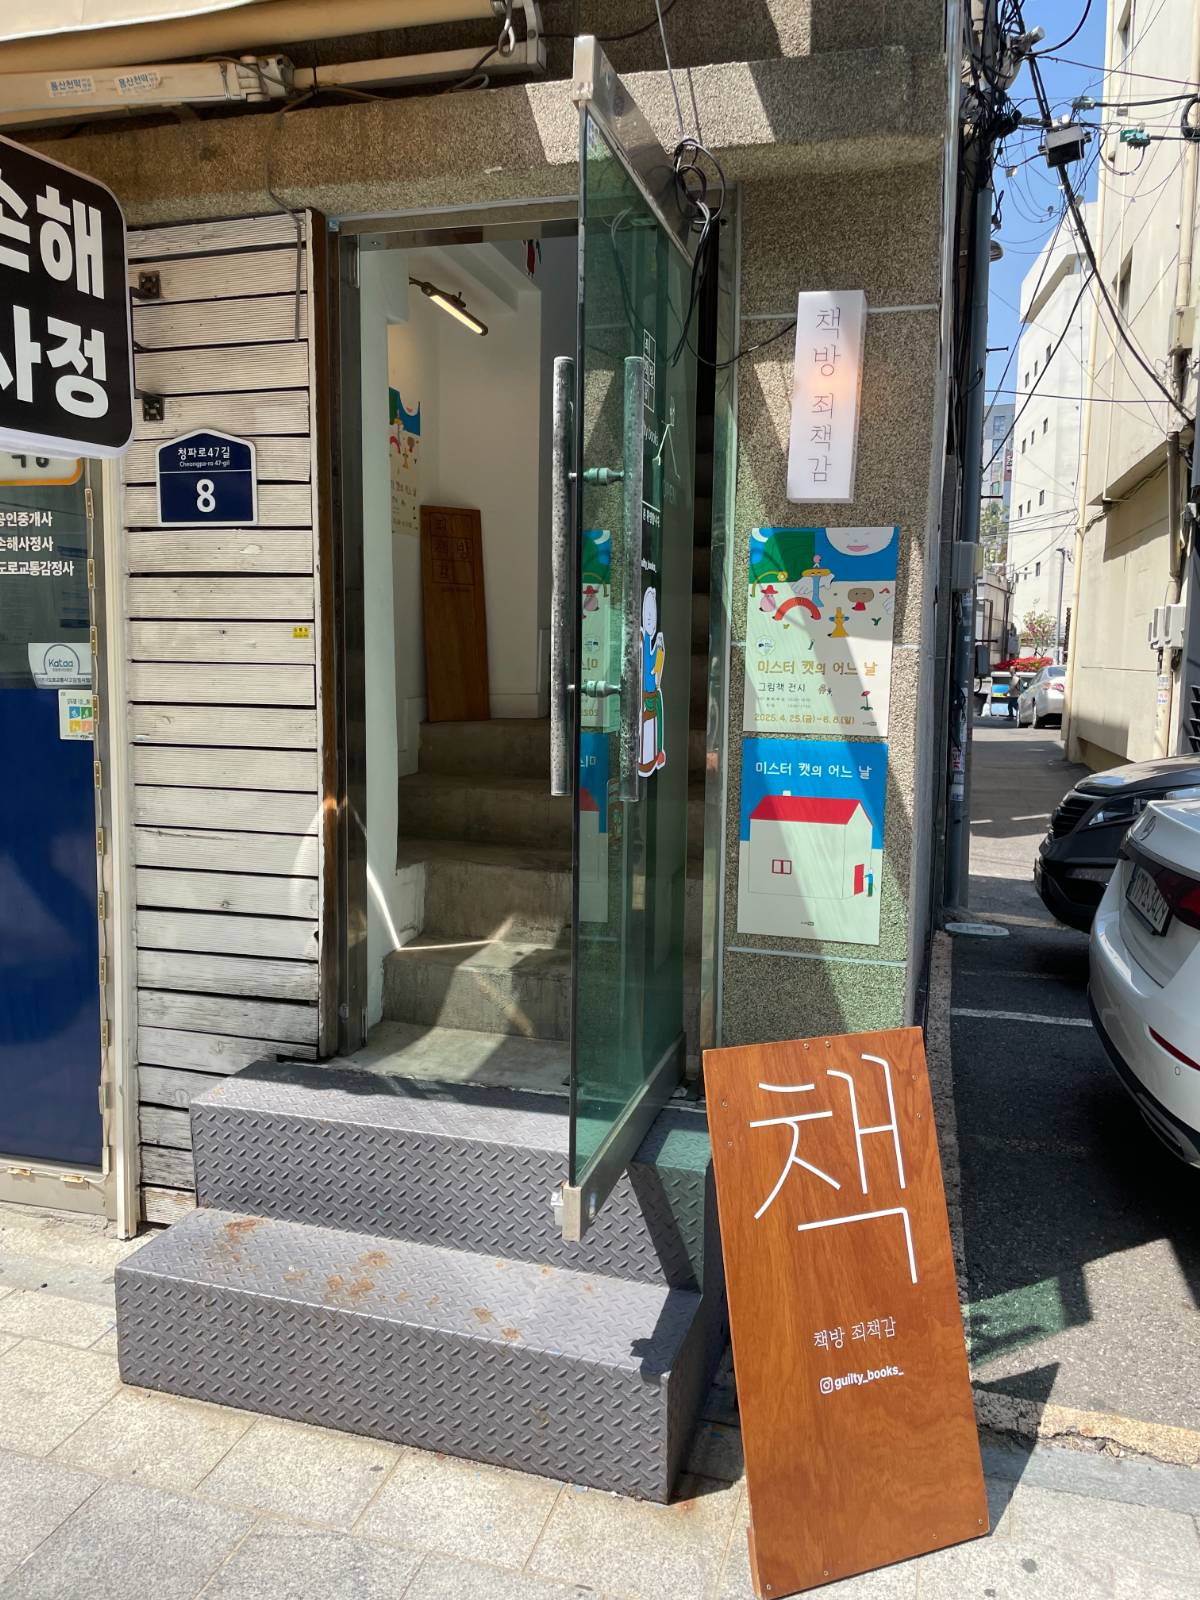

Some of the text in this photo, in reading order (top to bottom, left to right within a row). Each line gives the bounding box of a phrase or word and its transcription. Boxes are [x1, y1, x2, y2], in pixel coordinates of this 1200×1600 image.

[808, 304, 841, 483] 책방 죄책감
[178, 446, 230, 460] 청파로47길
[197, 478, 216, 512] 8
[757, 660, 795, 674] 미스터
[833, 662, 858, 675] 어느
[864, 662, 878, 676] 날
[758, 682, 806, 693] 그림책 전시
[755, 761, 792, 776] 미스터
[828, 765, 853, 778] 어느
[859, 765, 872, 780] 날
[750, 1054, 918, 1284] 책
[814, 1316, 897, 1351] 책방 죄책감
